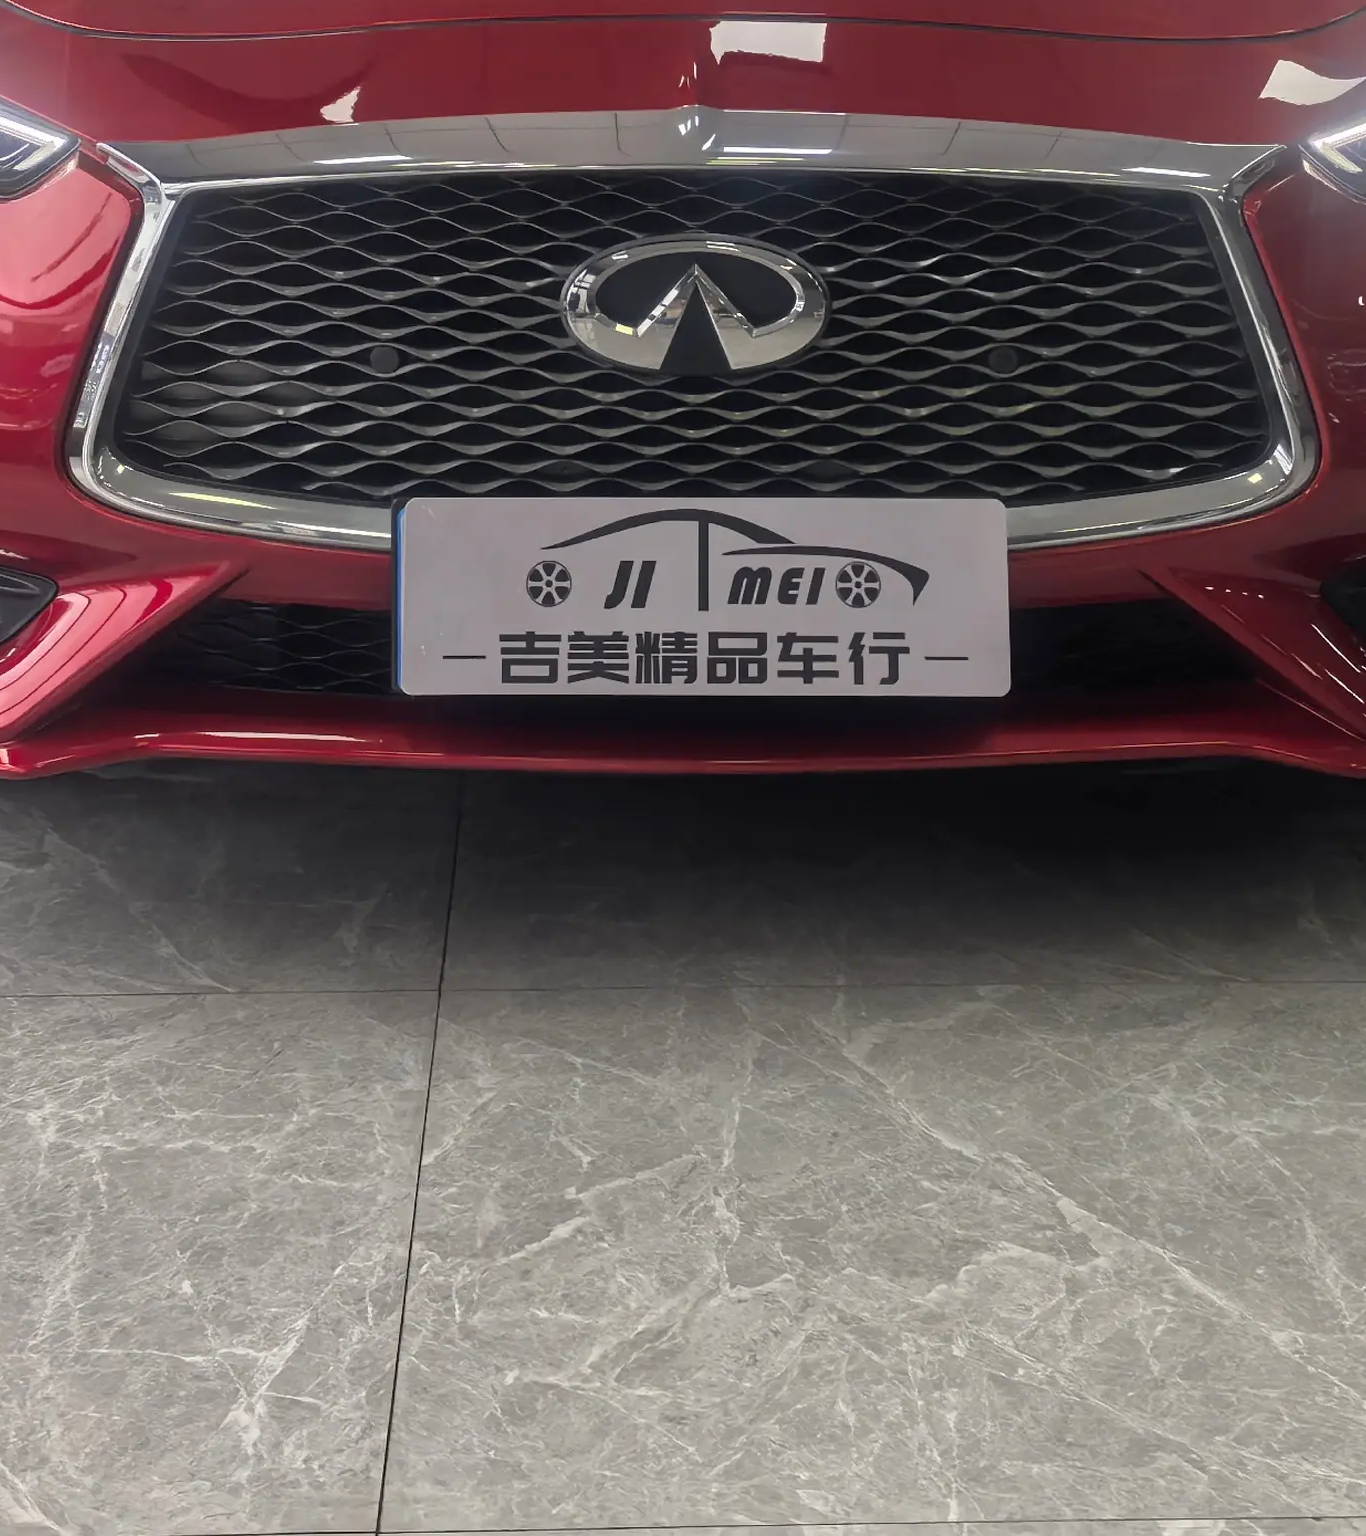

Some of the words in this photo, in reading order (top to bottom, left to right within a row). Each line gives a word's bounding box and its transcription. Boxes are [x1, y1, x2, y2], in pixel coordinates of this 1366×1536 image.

[603, 559, 658, 611] JI
[727, 564, 826, 607] MEI
[498, 630, 911, 685] 吉美精品车行
